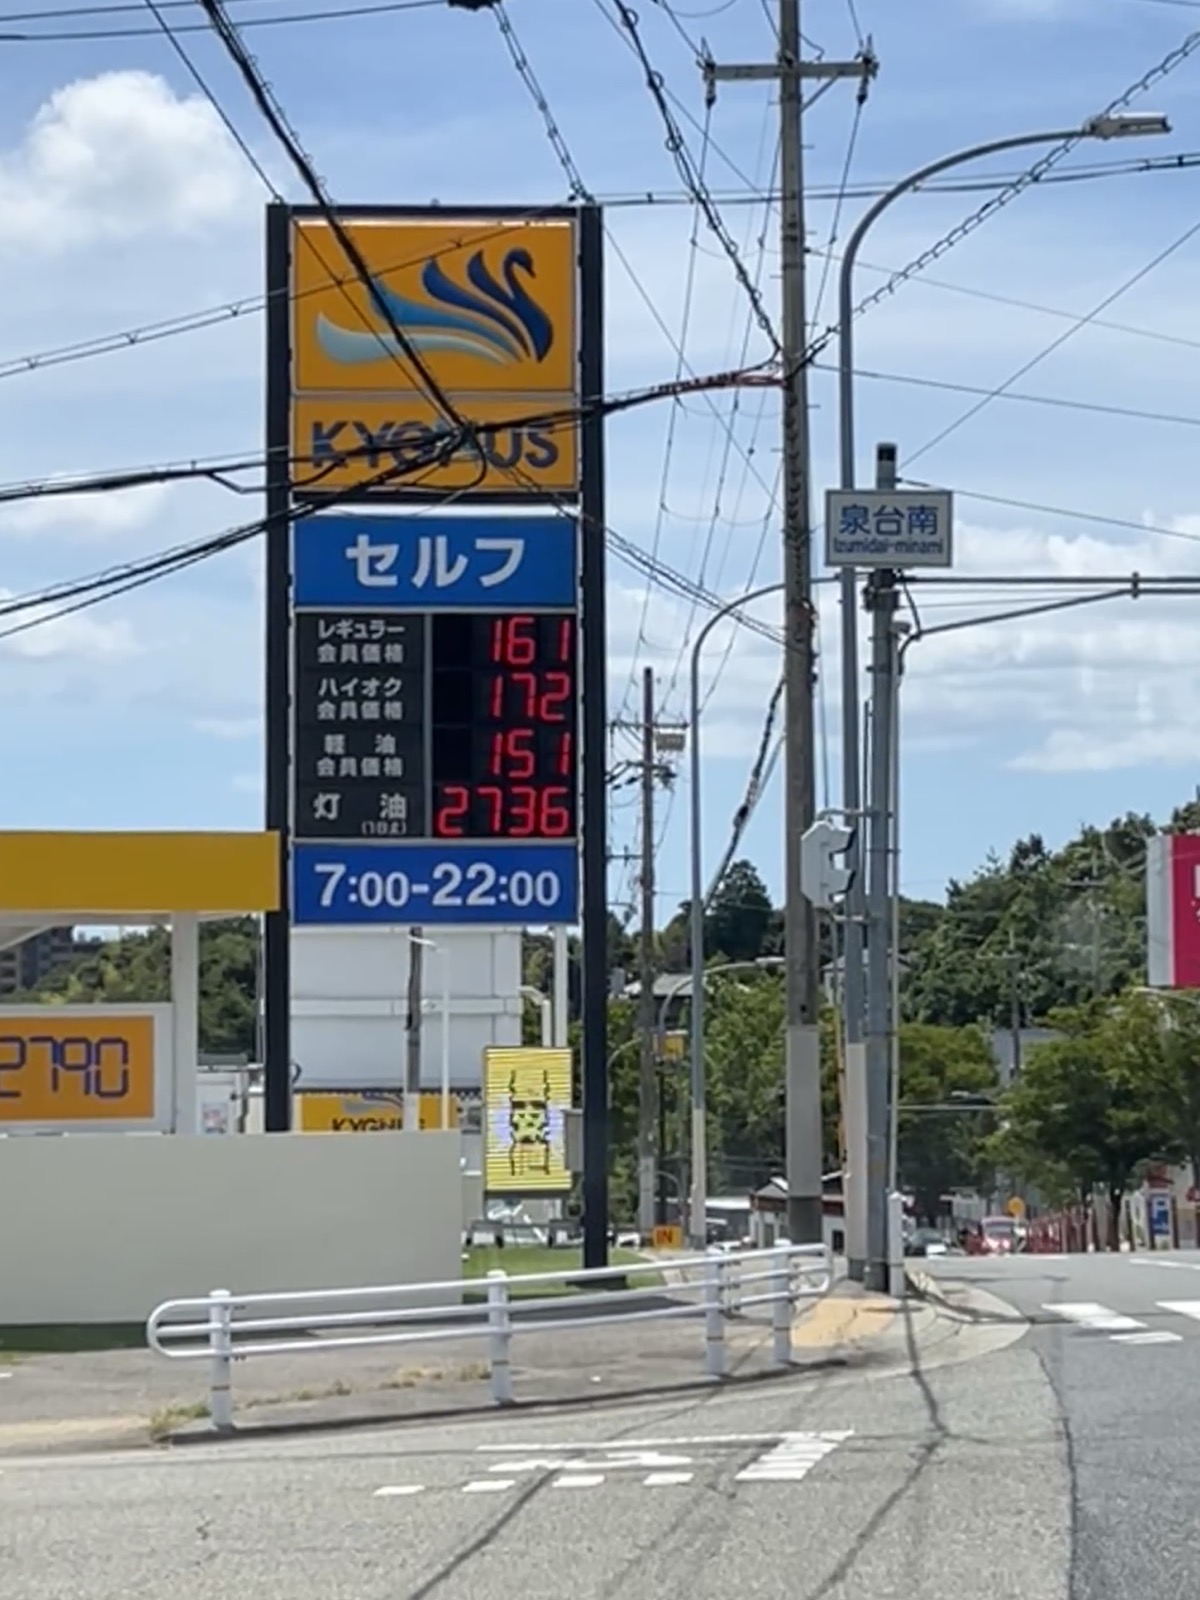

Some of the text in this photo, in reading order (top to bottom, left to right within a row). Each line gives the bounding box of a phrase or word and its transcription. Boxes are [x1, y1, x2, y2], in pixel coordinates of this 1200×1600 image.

[839, 504, 939, 536] 泉台南
[345, 533, 525, 588] セルフ
[317, 619, 405, 640] レギュラー
[492, 617, 571, 665] 161
[316, 643, 403, 664] 会員価格
[318, 677, 402, 696] ハイオク
[492, 673, 570, 721] 172
[316, 701, 403, 721] 会員価格
[316, 757, 403, 777] 会員価格
[492, 729, 571, 779] 151
[437, 786, 569, 836] 2736
[313, 862, 561, 908] 7:00-22:00
[0, 1036, 129, 1098] 2790
[656, 1228, 673, 1244] IN
